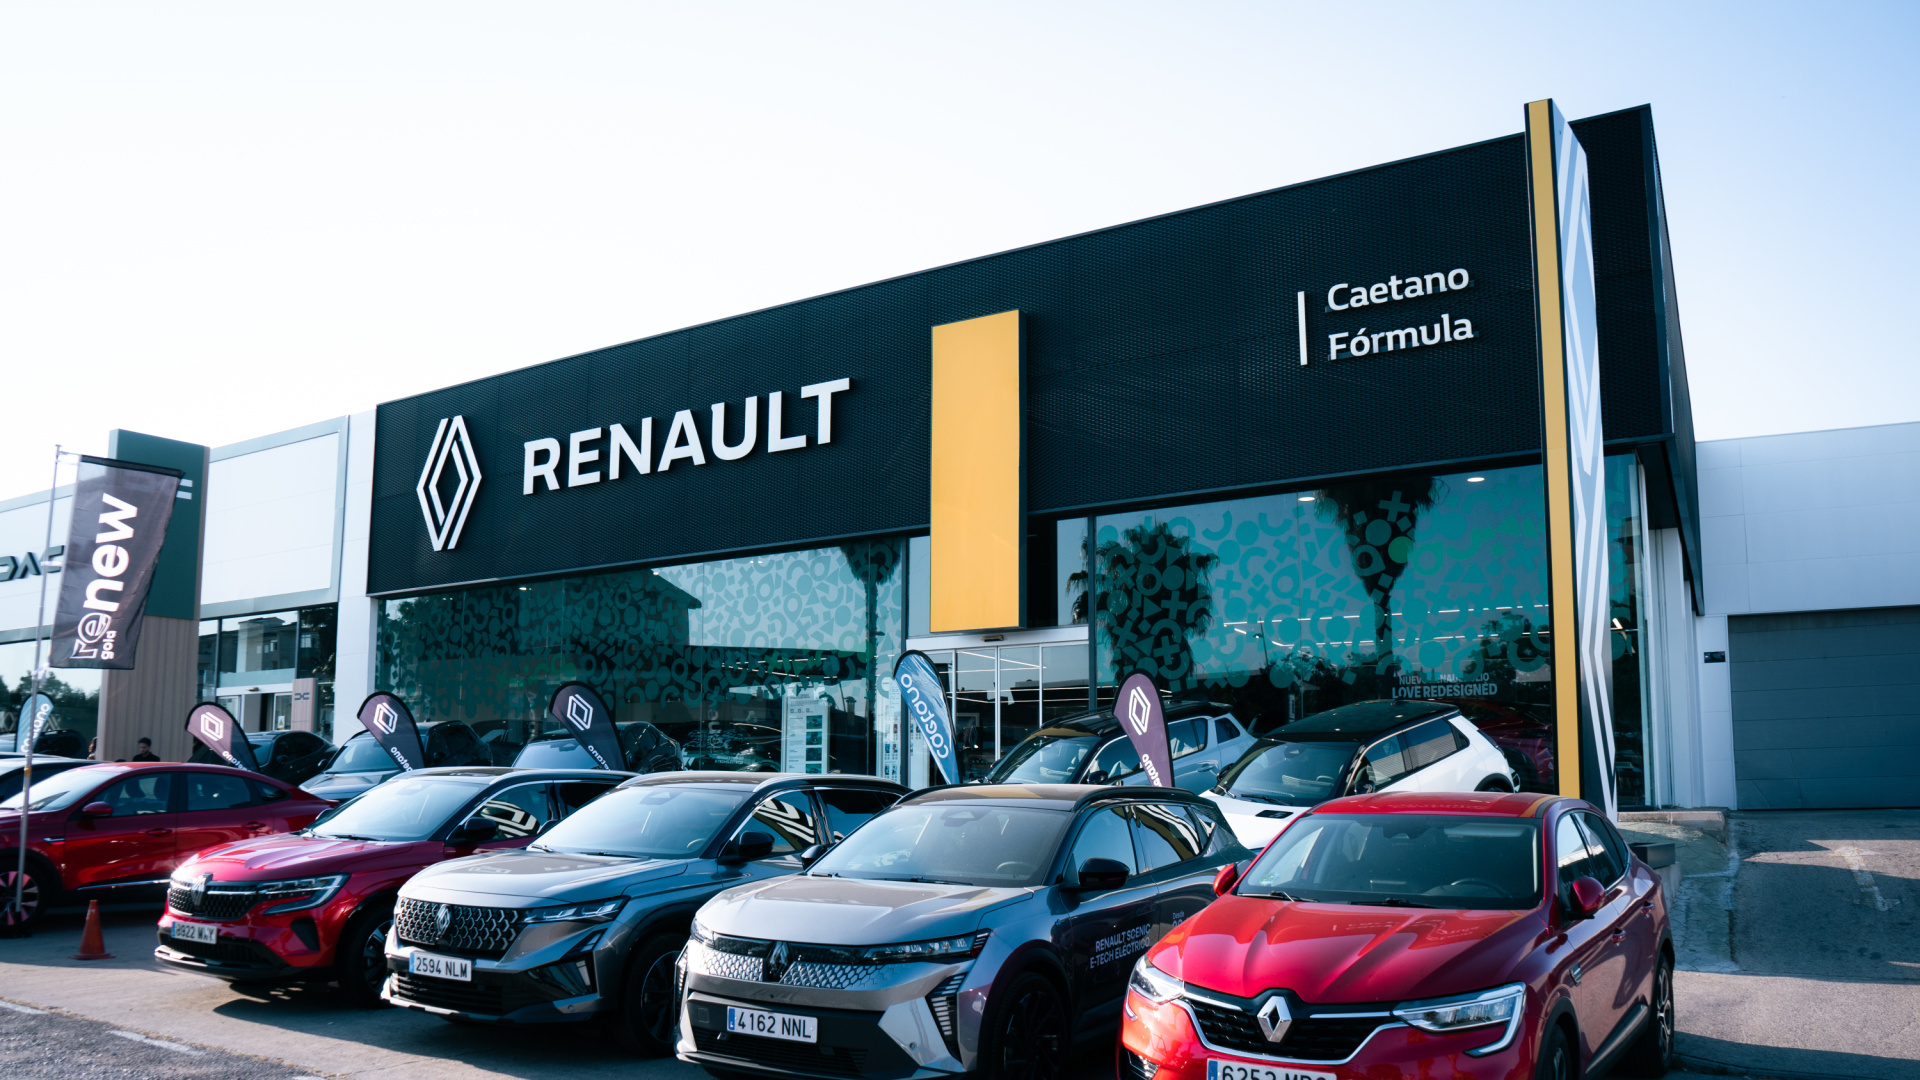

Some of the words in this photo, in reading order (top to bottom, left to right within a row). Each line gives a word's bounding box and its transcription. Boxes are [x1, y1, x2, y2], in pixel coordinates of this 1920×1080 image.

[1327, 267, 1470, 311] Caetano
[1328, 313, 1475, 361] Fórmula
[523, 377, 850, 495] RENAULT
[70, 492, 138, 659] renew
[100, 630, 117, 660] gold
[1391, 685, 1421, 699] LOVE
[1423, 682, 1498, 698] REDESIGNED
[1172, 909, 1185, 920] Desde
[1095, 931, 1127, 953] RENAULT
[1126, 923, 1151, 941] SCENIC
[416, 956, 442, 975] 2594
[445, 960, 468, 978] NLM
[1089, 951, 1114, 969] E-TECH
[737, 1011, 776, 1034] 4162
[781, 1016, 812, 1039] NNL
